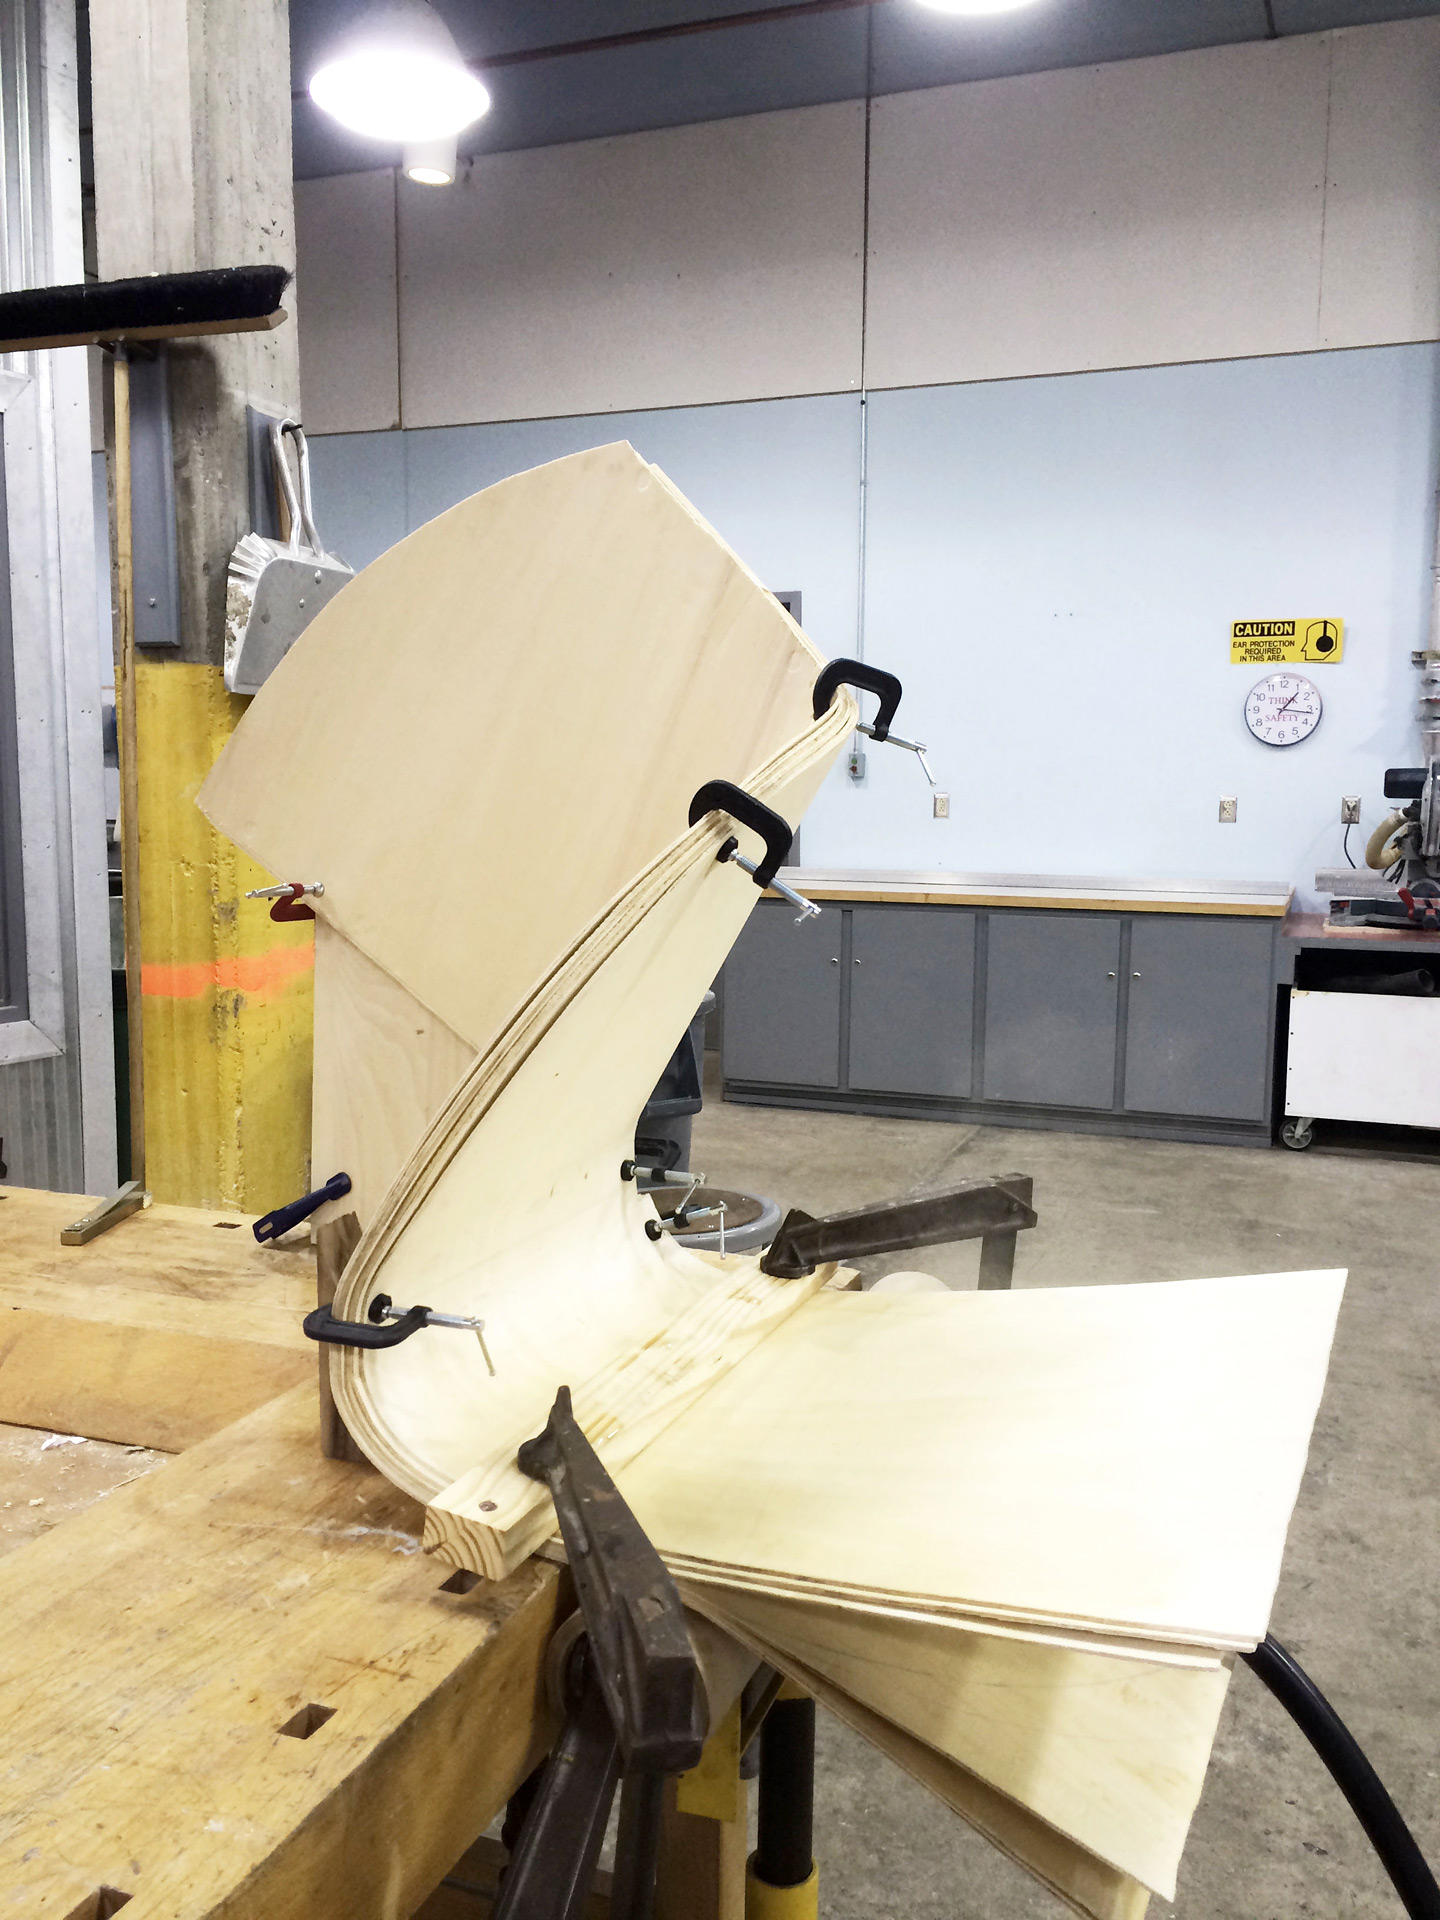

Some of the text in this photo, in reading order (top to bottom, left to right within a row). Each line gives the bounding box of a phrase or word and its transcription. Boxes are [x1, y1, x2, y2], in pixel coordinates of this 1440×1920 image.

[1235, 622, 1293, 636] CAUTION
[1280, 680, 1289, 688] 12
[1256, 693, 1266, 701] 10
[1304, 692, 1310, 700] 2
[1253, 706, 1260, 714] 9
[1306, 705, 1312, 713] 3
[1256, 718, 1262, 726] 8
[1292, 727, 1298, 735] 5
